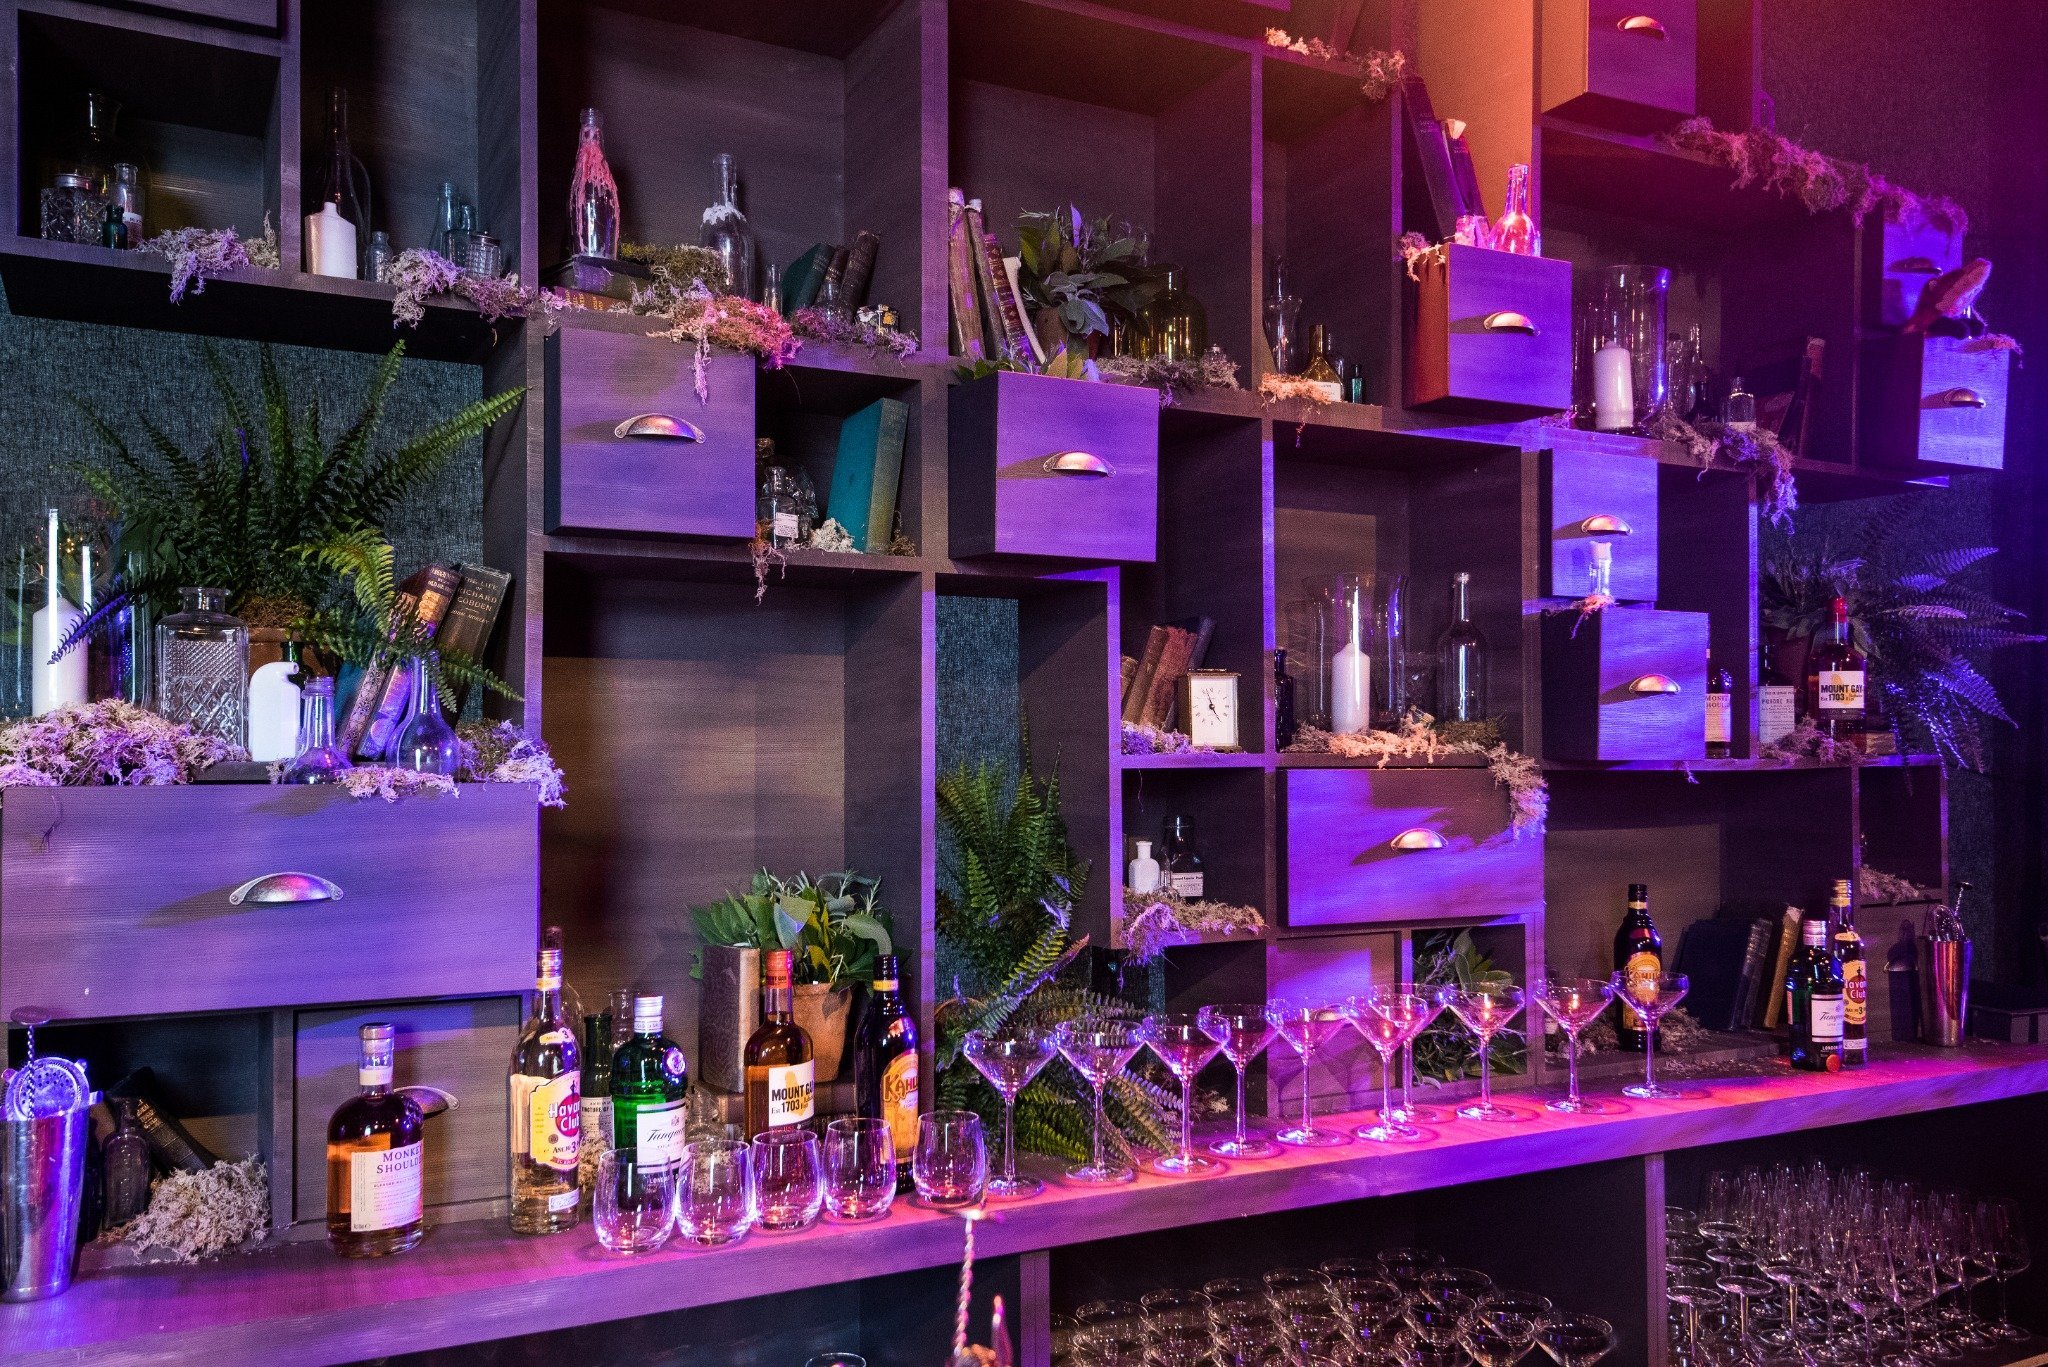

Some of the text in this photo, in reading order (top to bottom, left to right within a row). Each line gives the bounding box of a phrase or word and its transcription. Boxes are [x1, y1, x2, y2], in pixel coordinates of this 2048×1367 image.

[457, 596, 492, 611] COBDEN
[1821, 685, 1863, 693] MOUNT GAY
[1828, 693, 1845, 701] 1703
[771, 1085, 805, 1102] MOUNT
[781, 1099, 800, 1113] 1703
[571, 1141, 577, 1154] 3
